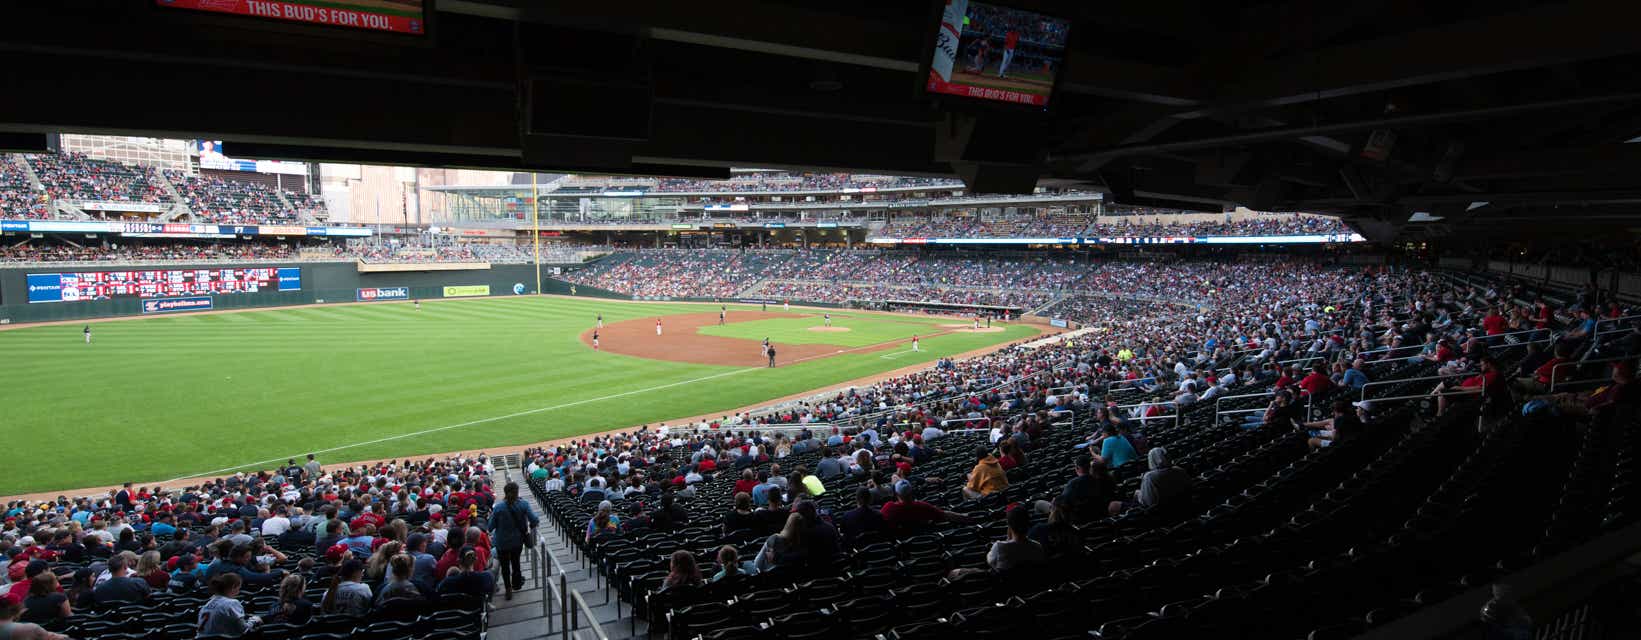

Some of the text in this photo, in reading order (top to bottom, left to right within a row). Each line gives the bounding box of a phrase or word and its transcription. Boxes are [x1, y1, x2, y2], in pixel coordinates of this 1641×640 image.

[246, 0, 393, 30] THIS BUD'S FOR YOU.
[968, 86, 984, 97] THIS
[984, 88, 1005, 100] BUD'S
[1005, 92, 1019, 102] FOR
